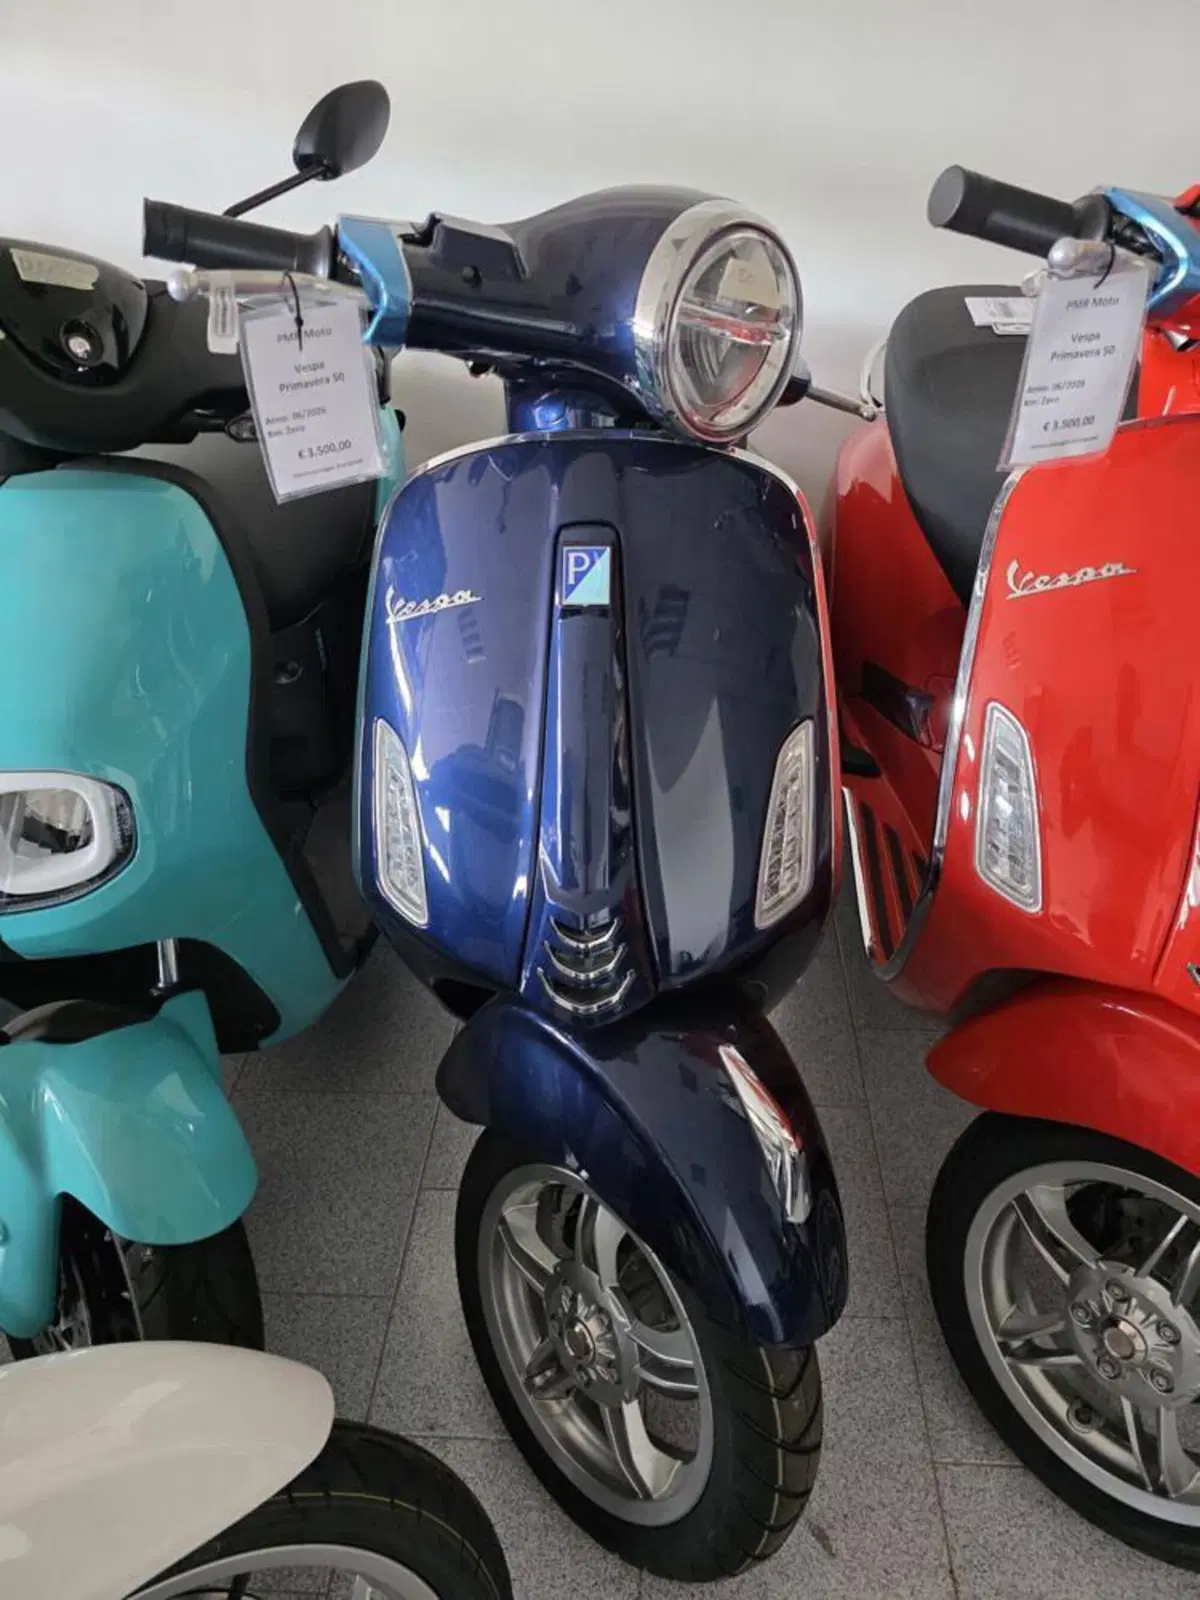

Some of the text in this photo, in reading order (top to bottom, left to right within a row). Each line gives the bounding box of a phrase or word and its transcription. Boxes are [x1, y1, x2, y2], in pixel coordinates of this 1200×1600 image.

[1091, 296, 1119, 308] Moto
[303, 327, 332, 340] Moto
[1071, 332, 1101, 344] Vespa
[1050, 345, 1116, 362] Primavera 50
[294, 361, 325, 374] Vespa
[279, 371, 345, 392] Primavera 50
[1005, 559, 1137, 601] Vespa
[385, 584, 482, 625] Vespa
